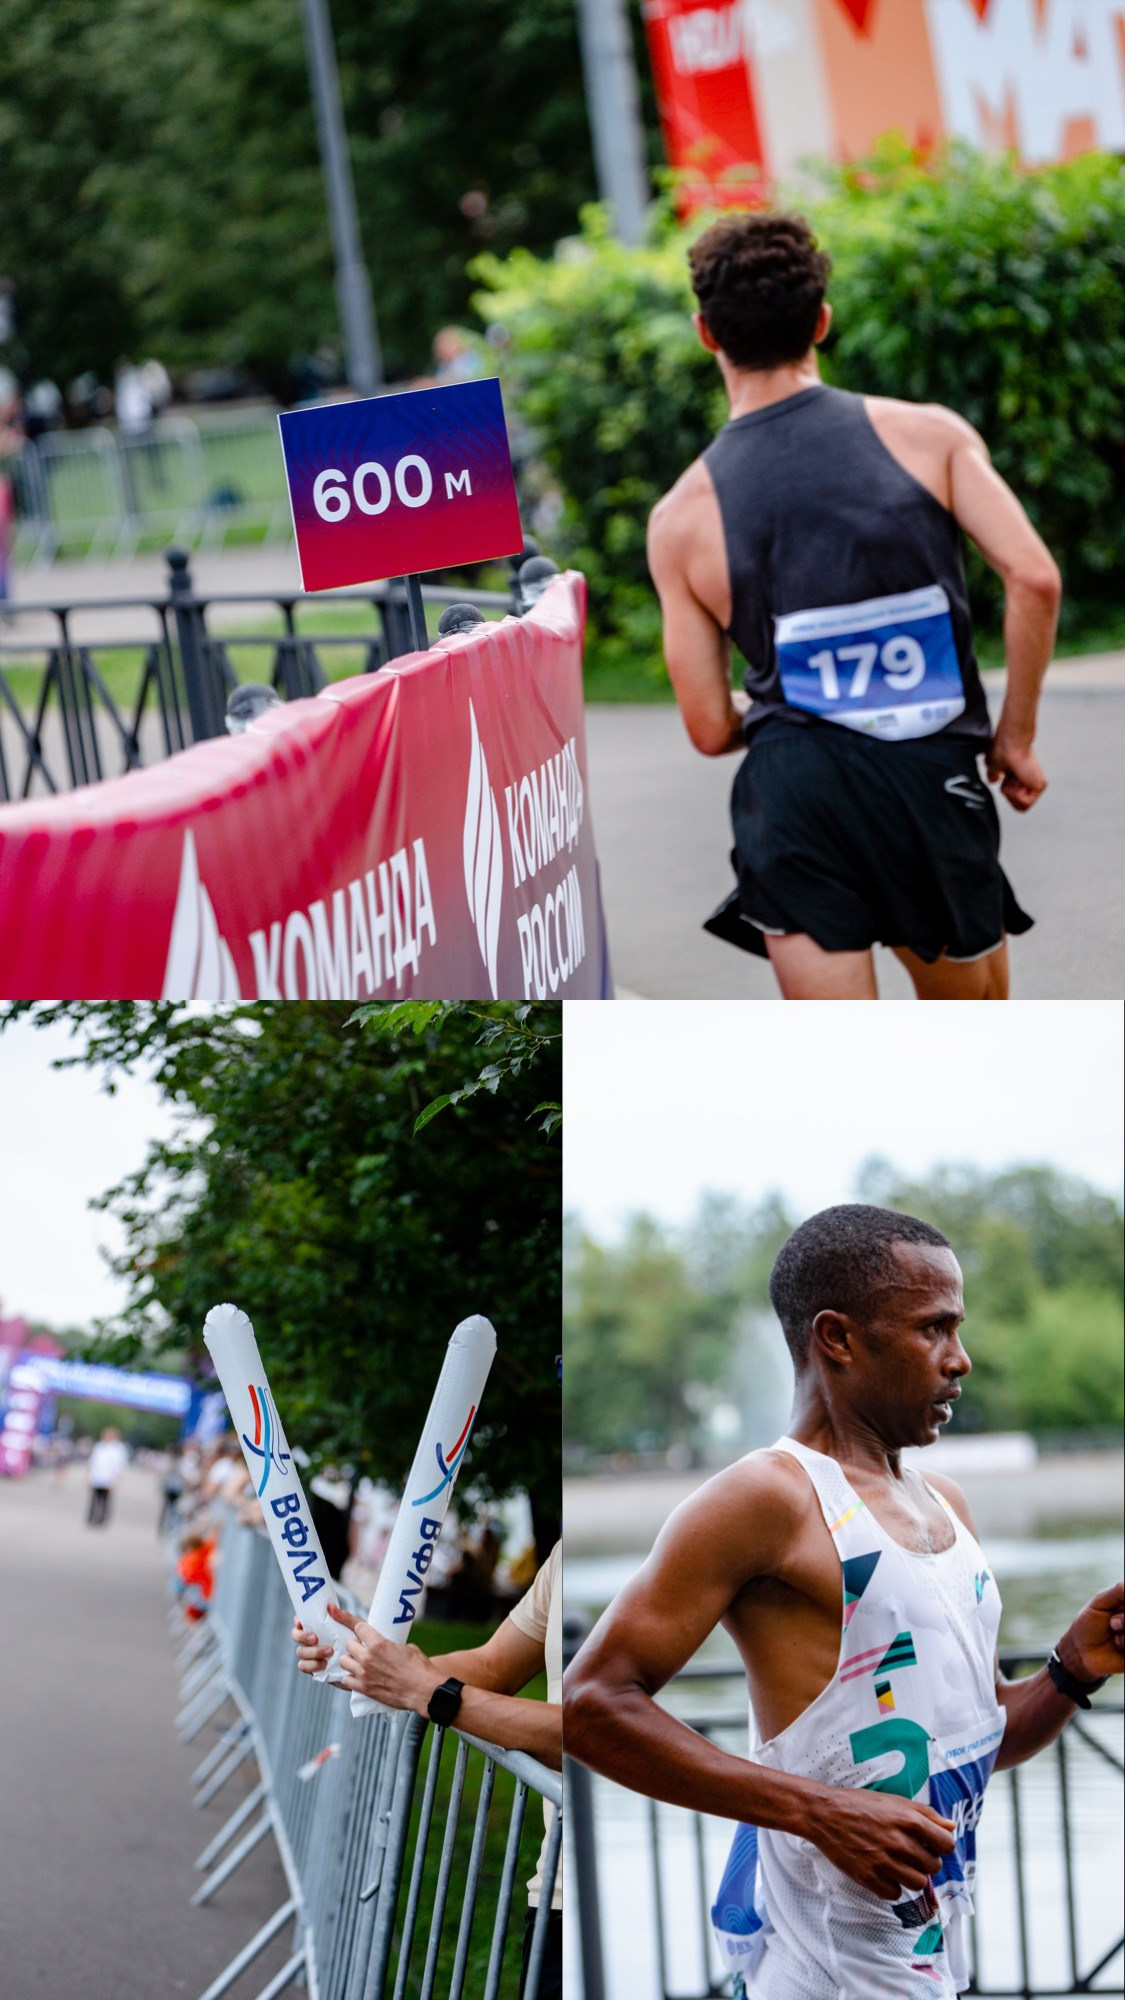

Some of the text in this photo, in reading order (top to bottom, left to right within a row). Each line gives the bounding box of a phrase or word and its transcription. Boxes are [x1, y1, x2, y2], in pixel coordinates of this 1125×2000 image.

[312, 454, 433, 523] 600
[807, 635, 926, 700] 179
[504, 737, 583, 889] КОМАНДА
[248, 837, 436, 1000] КОМАНДА
[516, 864, 586, 1000] РОССИИ
[270, 1493, 326, 1603] ВФЛА
[392, 1517, 443, 1625] ВФЛА
